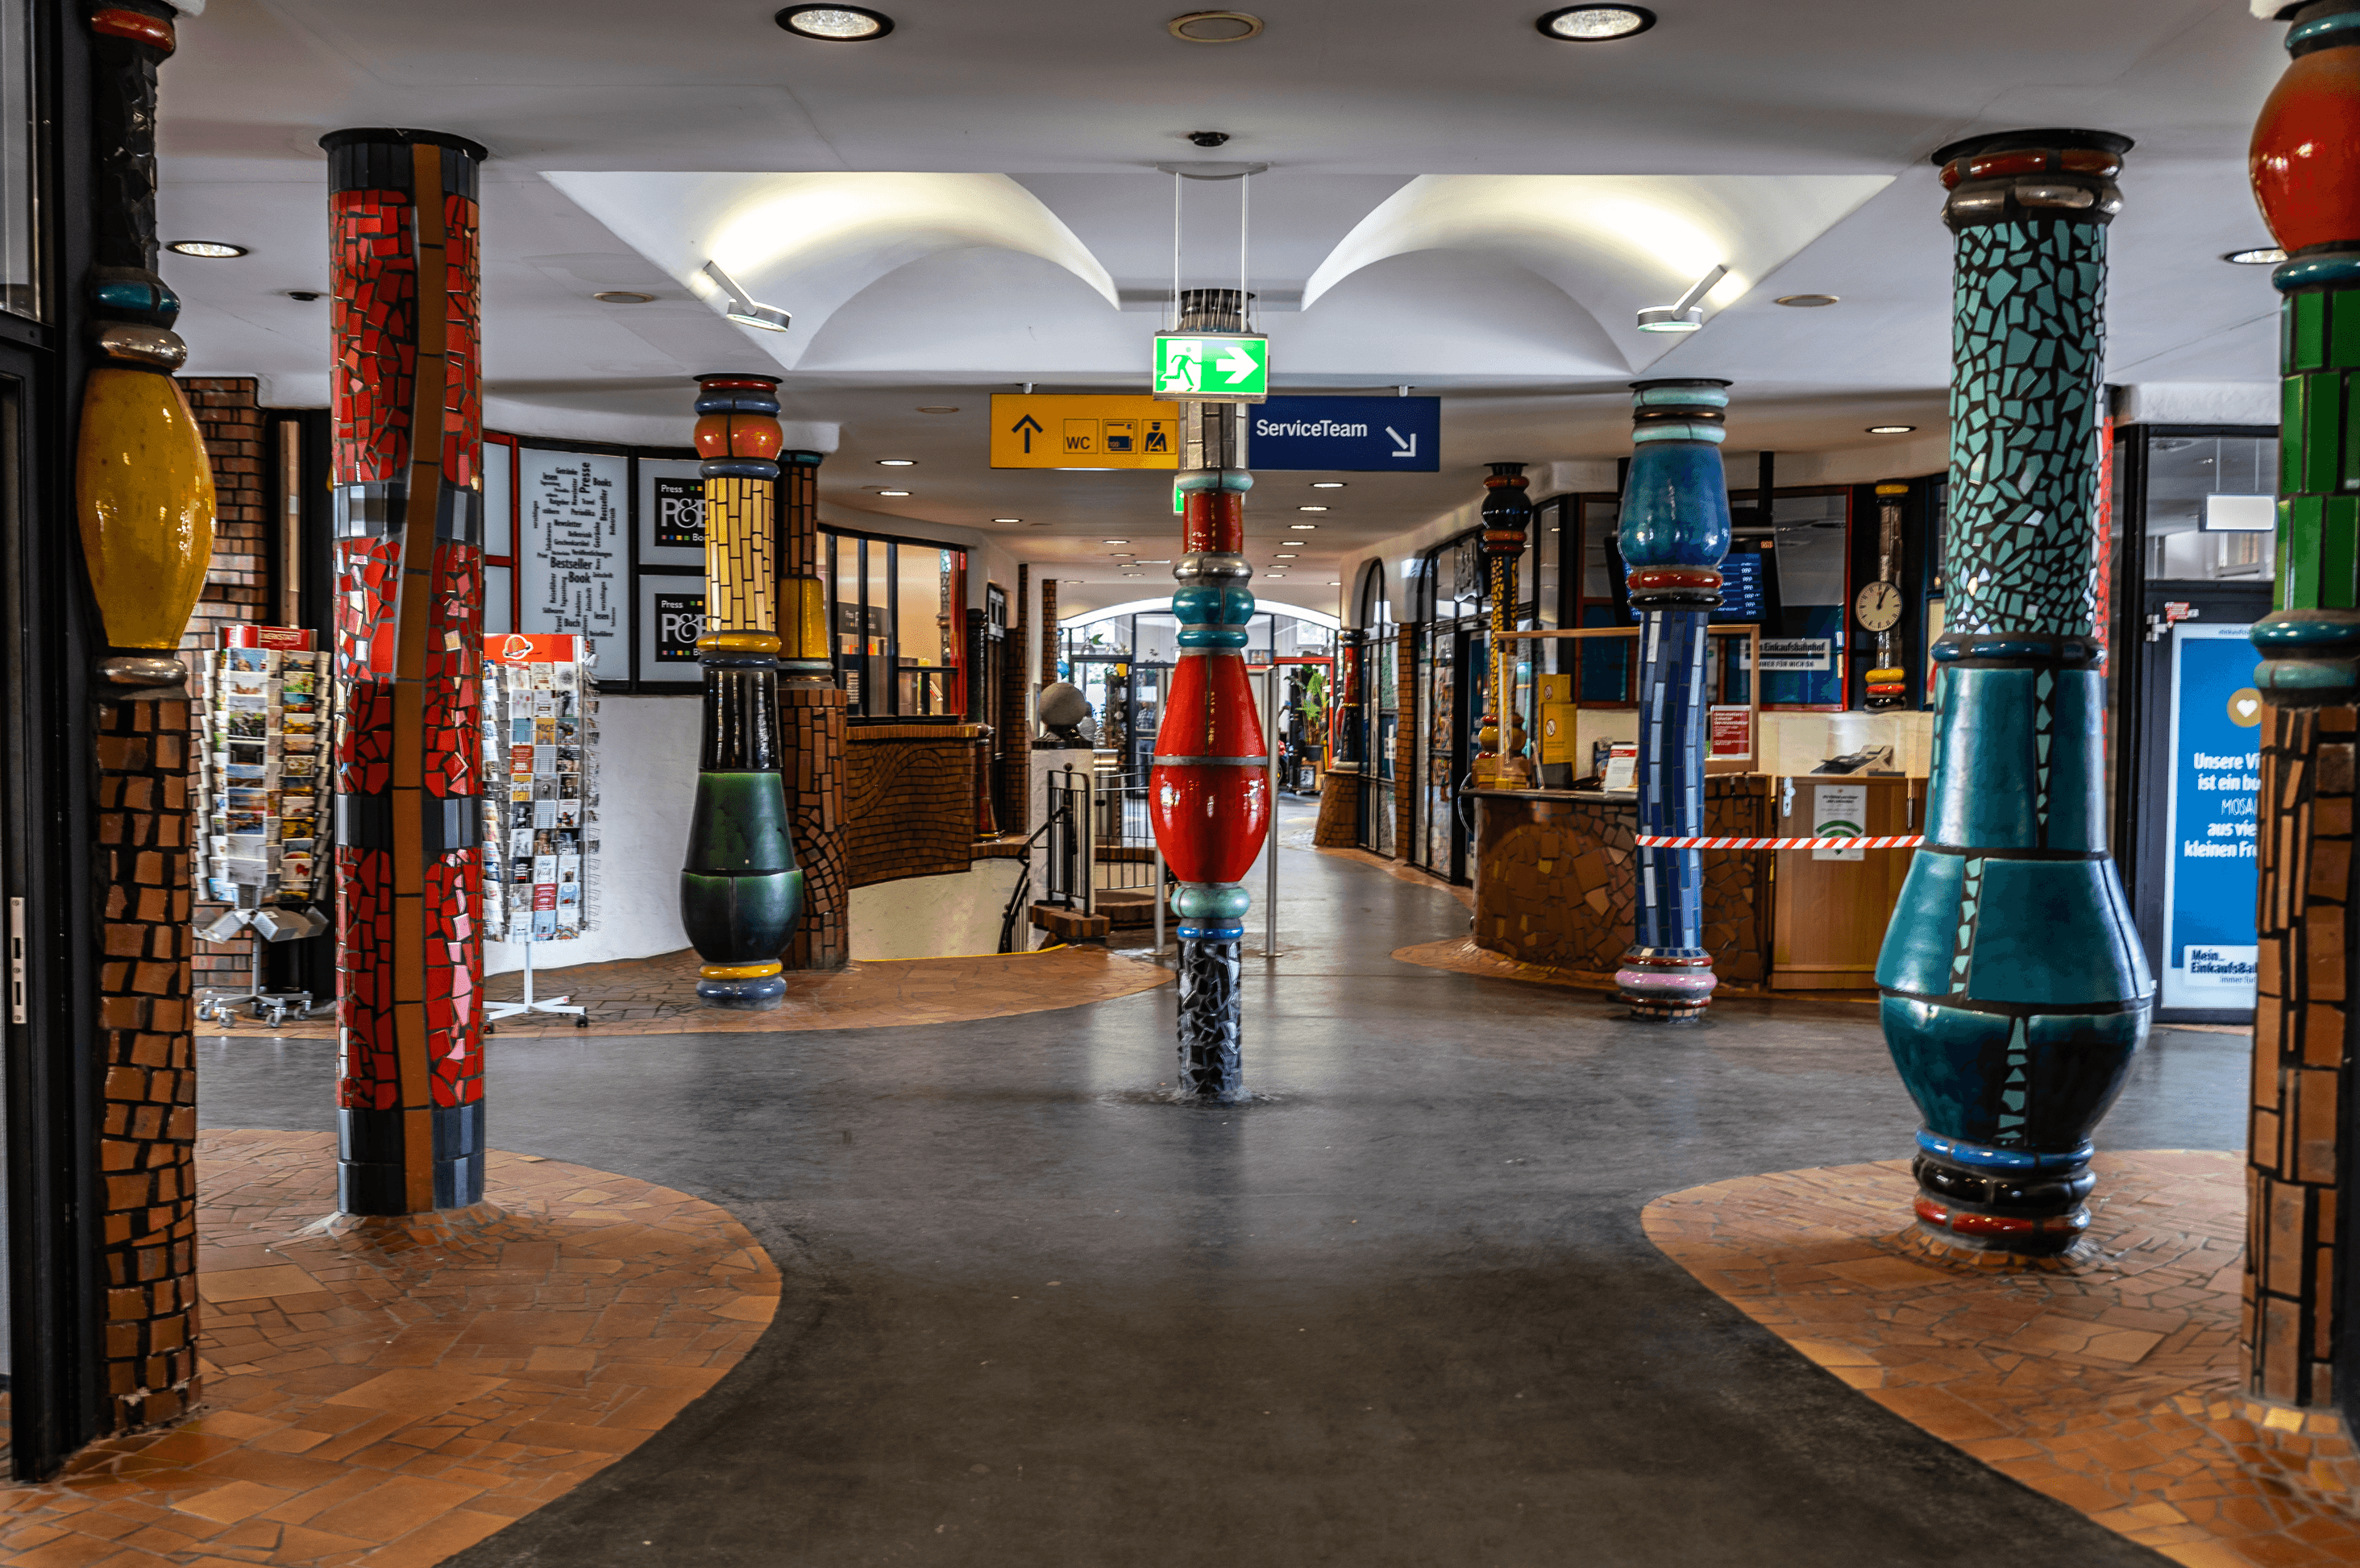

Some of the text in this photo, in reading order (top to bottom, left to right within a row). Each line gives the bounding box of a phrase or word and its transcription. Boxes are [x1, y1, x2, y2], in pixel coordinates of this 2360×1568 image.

[1256, 419, 1368, 437] ServiceTeam
[1066, 436, 1091, 450] WC
[579, 462, 591, 493] Presse
[592, 477, 613, 487] Books
[661, 484, 683, 493] Press
[599, 489, 609, 521] Bestseller
[593, 521, 601, 548] Getränke
[551, 556, 592, 570] Bestseller
[568, 570, 592, 583] Book
[661, 600, 683, 608] Press
[555, 616, 563, 633] Travel
[564, 617, 581, 627] Buch
[2194, 753, 2244, 769] Unsere
[2198, 773, 2217, 790] ist
[2217, 774, 2241, 790] ein
[2208, 823, 2233, 836] aus
[2184, 840, 2237, 857] kleinen
